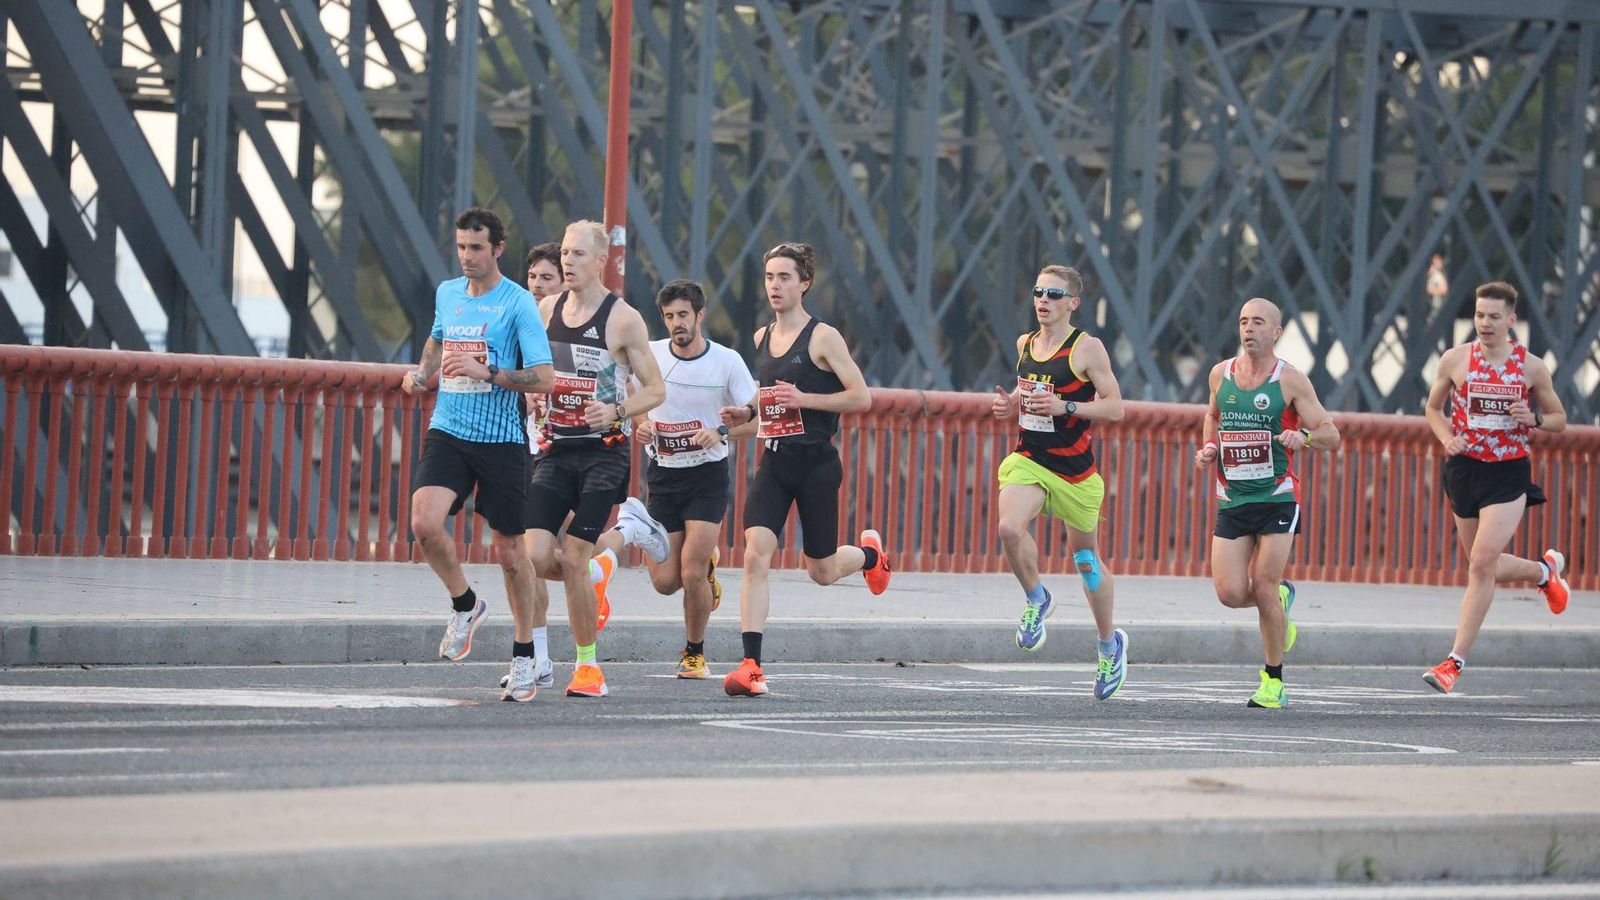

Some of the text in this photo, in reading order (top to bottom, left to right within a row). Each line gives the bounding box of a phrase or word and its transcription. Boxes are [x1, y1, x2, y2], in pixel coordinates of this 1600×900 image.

[446, 323, 488, 337] woon!
[451, 342, 484, 351] GENERALI
[558, 380, 592, 389] GENERALI
[1483, 385, 1517, 395] GENERALI
[558, 394, 582, 406] 4350
[1479, 400, 1509, 410] 15615
[765, 405, 786, 415] 5289
[666, 422, 699, 432] GENERALI
[1229, 449, 1260, 459] 11810
